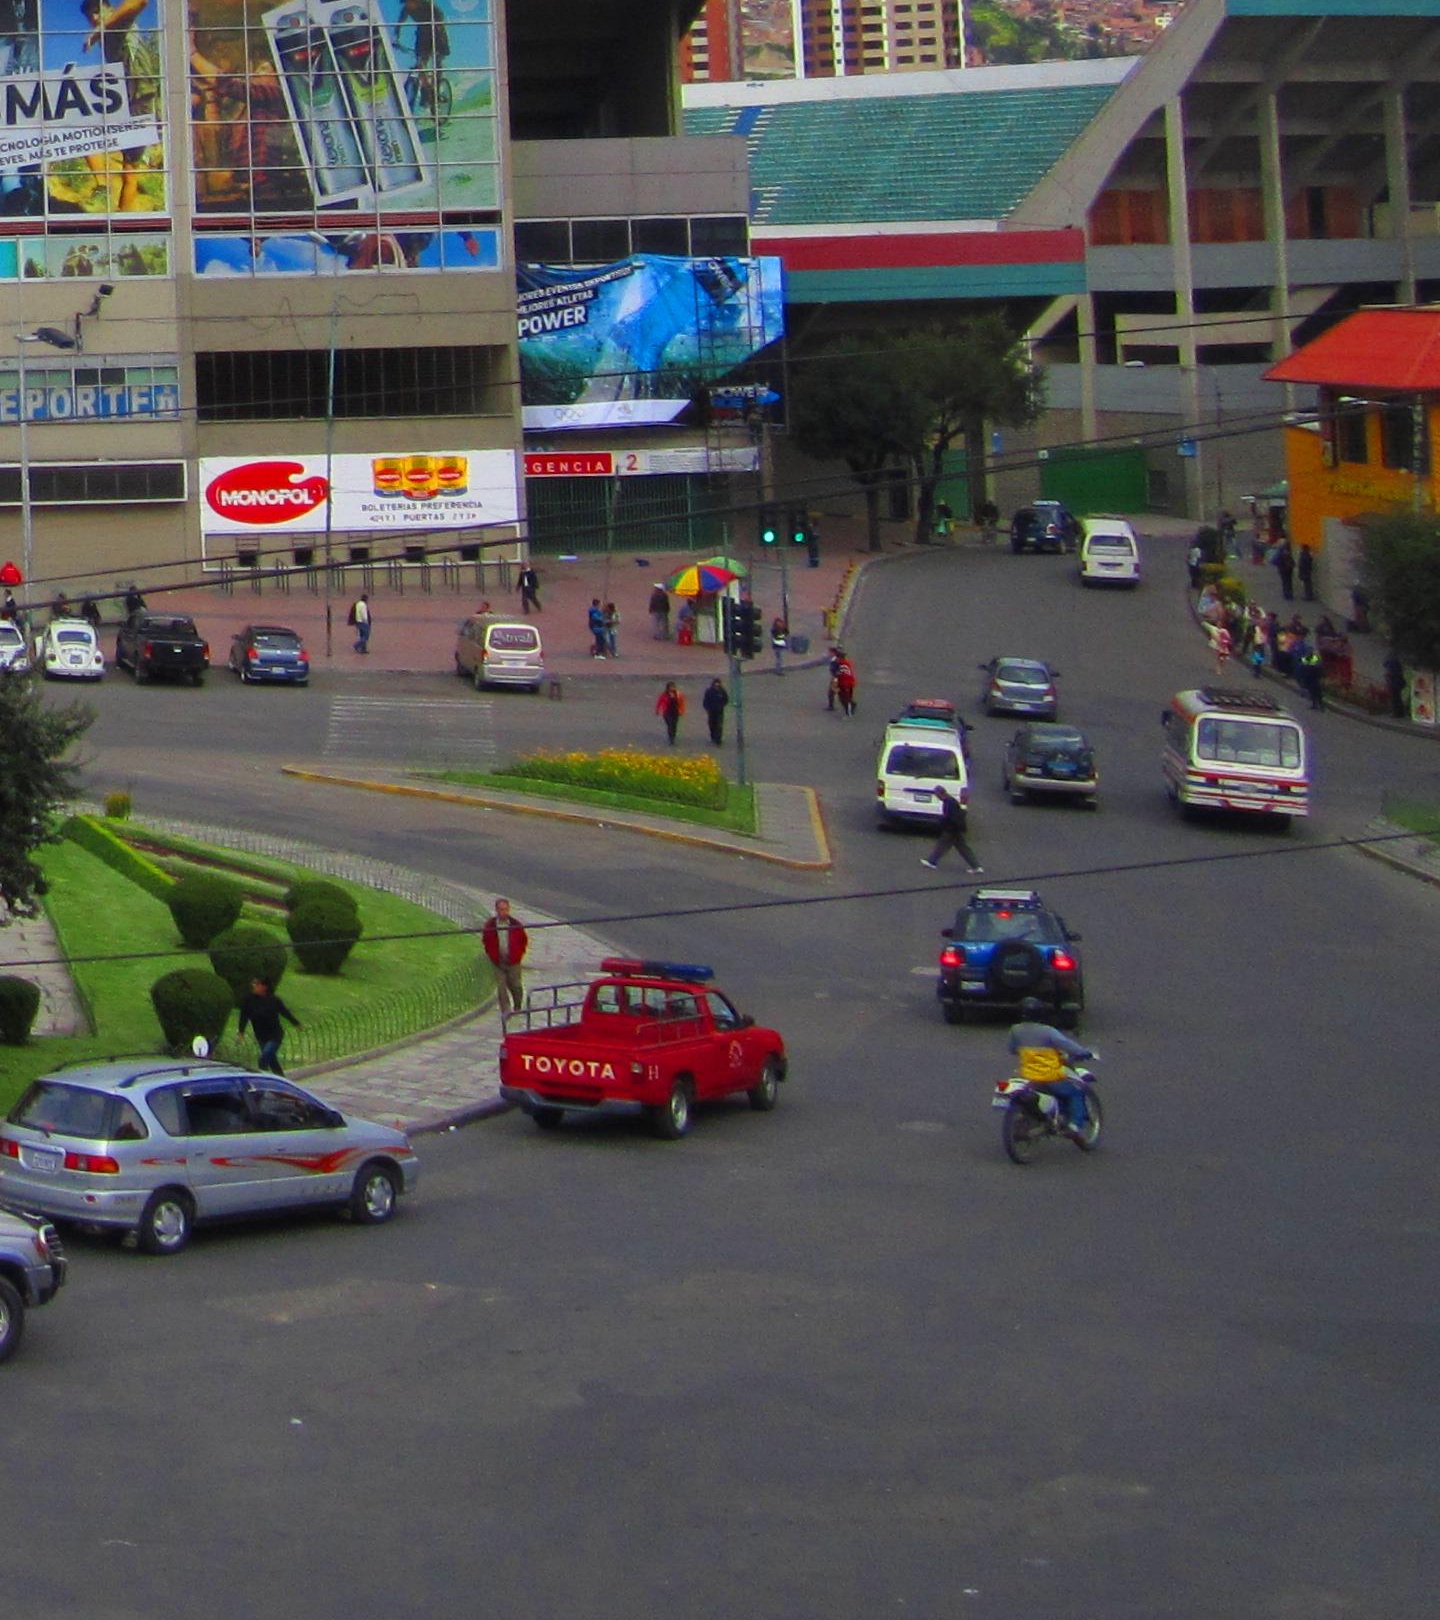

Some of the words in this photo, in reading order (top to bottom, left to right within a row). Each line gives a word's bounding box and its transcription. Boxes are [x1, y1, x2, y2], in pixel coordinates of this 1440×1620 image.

[54, 146, 68, 157] TE
[69, 137, 119, 154] PROTEGE
[517, 305, 587, 337] POWER
[626, 454, 638, 471] 2
[220, 488, 314, 507] MONOPOL
[361, 503, 417, 512] BOLETERIAS
[420, 501, 484, 510] PREFERENCIA
[403, 513, 445, 521] PUERTAS
[520, 1054, 616, 1080] TOYOTA
